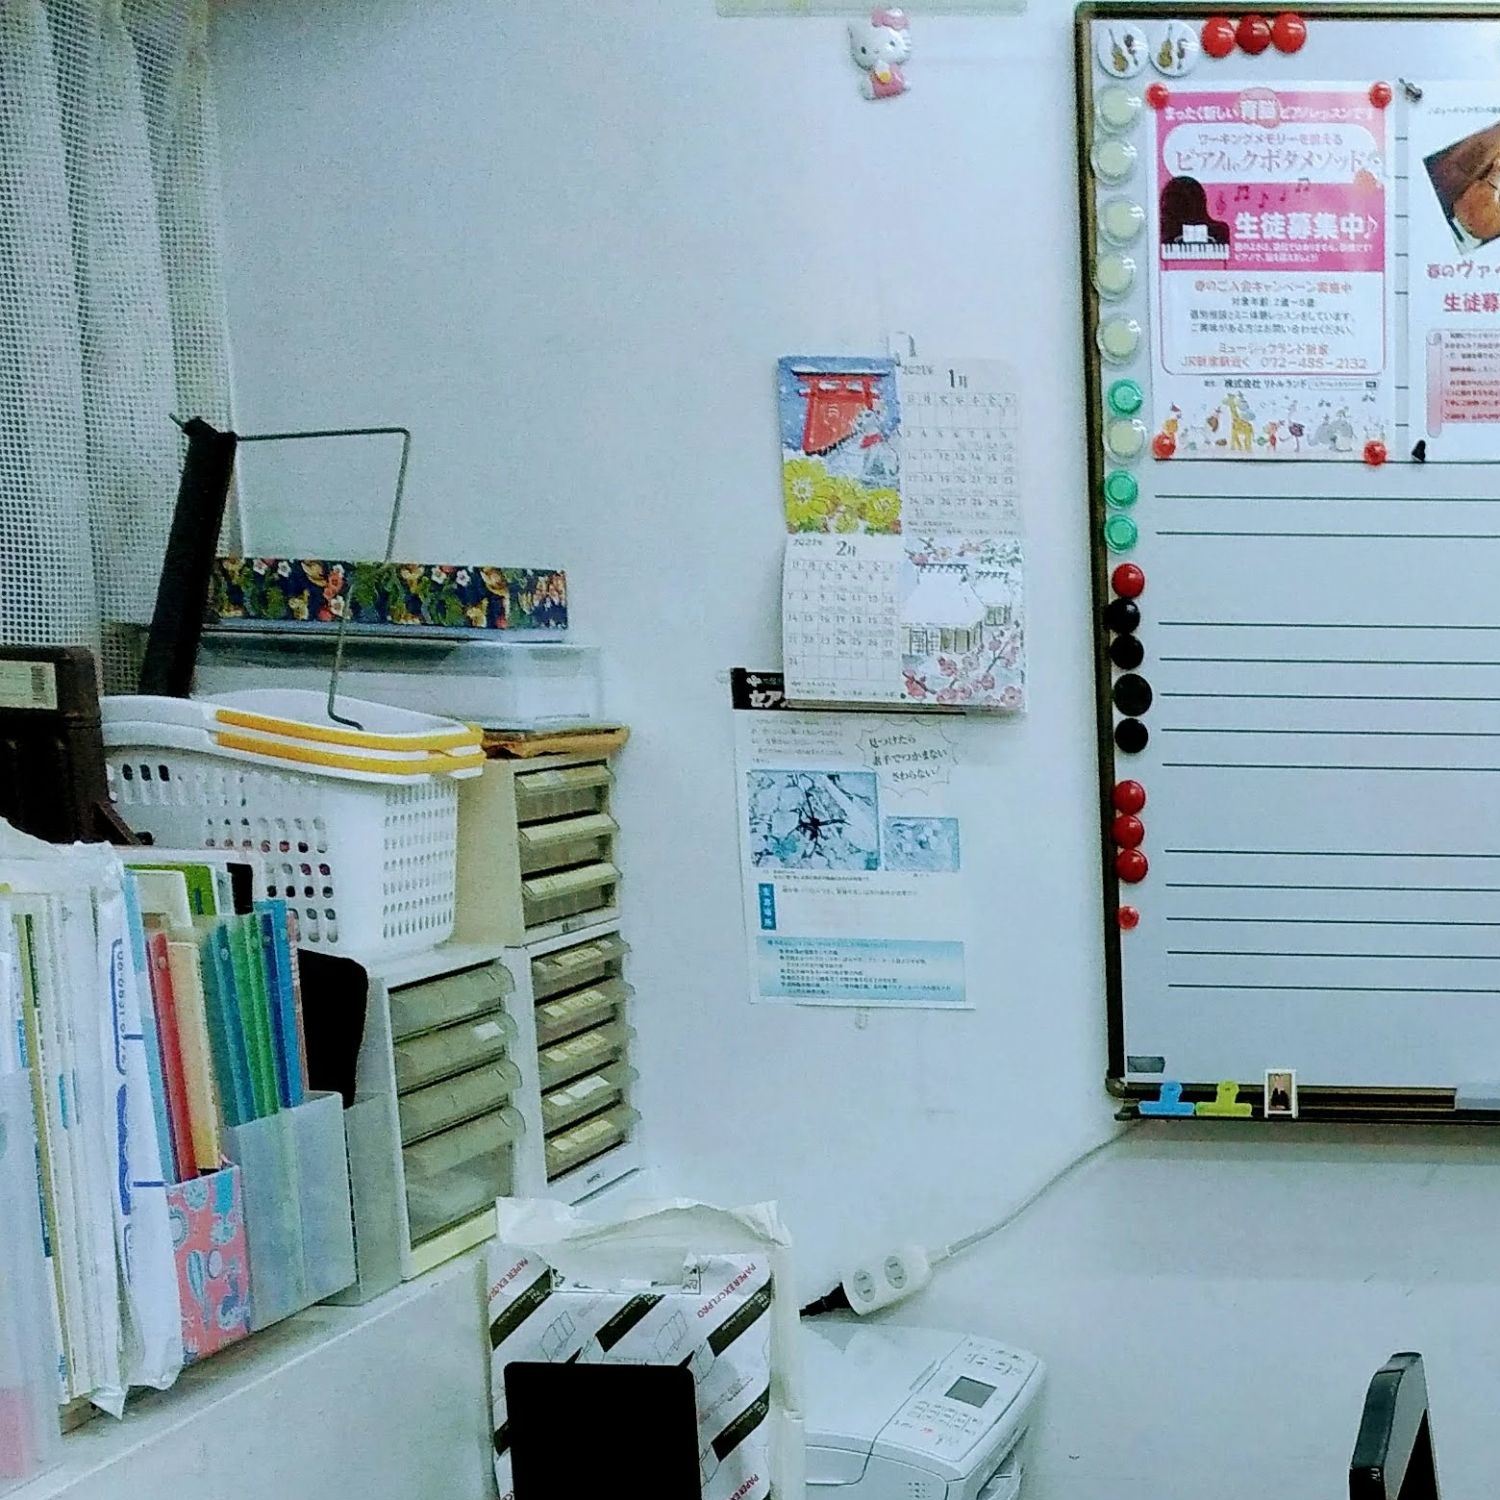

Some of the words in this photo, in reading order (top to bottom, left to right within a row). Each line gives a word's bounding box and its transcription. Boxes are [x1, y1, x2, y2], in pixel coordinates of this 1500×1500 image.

[1233, 212, 1366, 241] 生徒募集中
